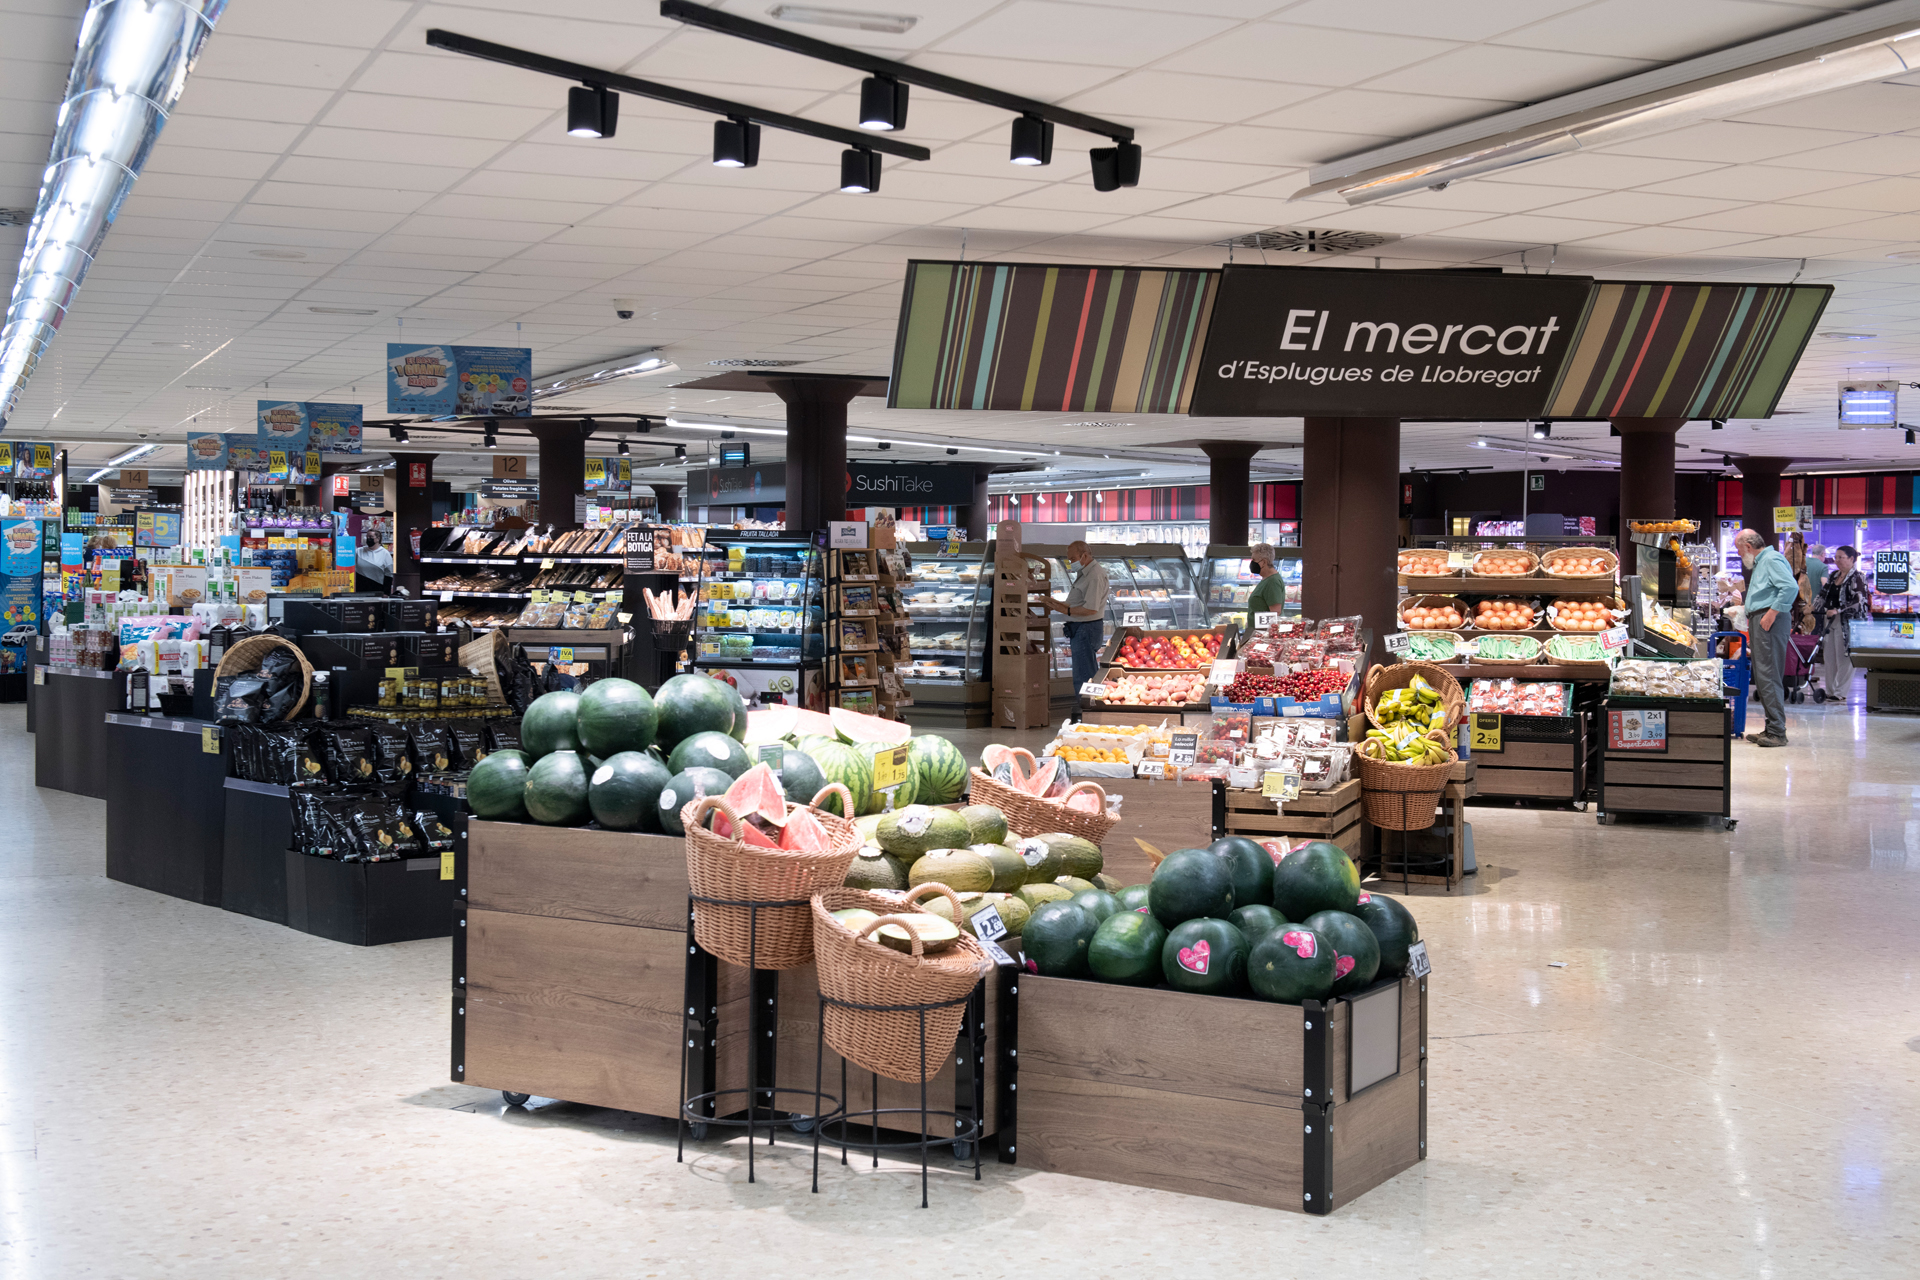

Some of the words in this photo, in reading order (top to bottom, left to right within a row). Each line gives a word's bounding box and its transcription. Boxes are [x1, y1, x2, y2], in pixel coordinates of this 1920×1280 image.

[1279, 309, 1329, 351] El
[1343, 316, 1560, 355] mercat
[1380, 364, 1414, 383] de
[1421, 365, 1542, 388] Llobregat
[0, 449, 10, 458] VA
[36, 450, 50, 460] IVA
[270, 456, 286, 465] IVA
[306, 458, 320, 466] IVA
[502, 457, 518, 472] 12
[586, 464, 604, 472] IVA
[620, 465, 630, 473] IVA
[128, 472, 142, 483] 14
[367, 476, 380, 487] 15
[856, 474, 933, 492] SushiTake
[719, 477, 742, 493] SushiTake
[628, 532, 638, 541] FET
[645, 532, 653, 541] LA
[628, 542, 653, 552] BOTIGA
[1878, 553, 1891, 562] FET
[1898, 553, 1907, 562] LA
[1878, 562, 1908, 573] BOTIGA
[1476, 732, 1498, 745] 2,70
[893, 769, 905, 781] 1,75
[982, 920, 1002, 936] 2,69
